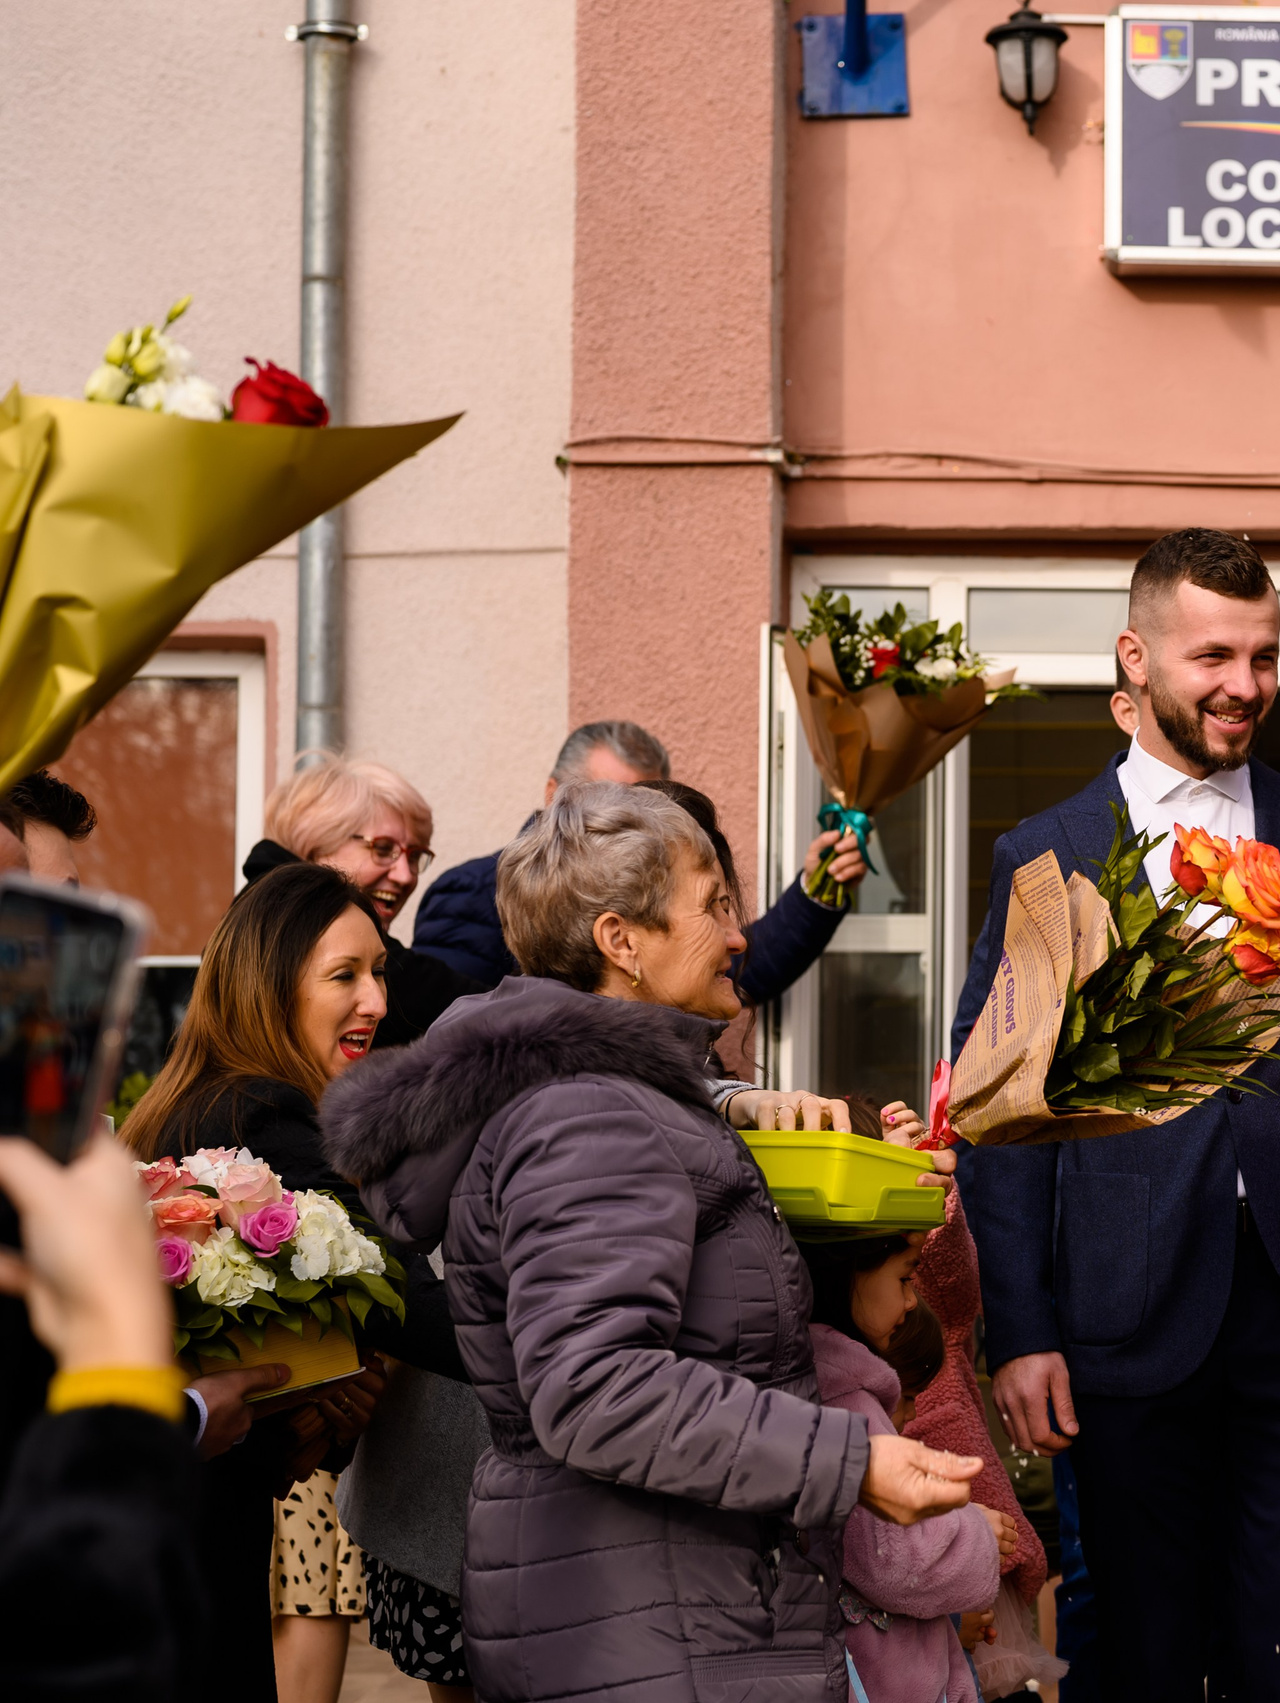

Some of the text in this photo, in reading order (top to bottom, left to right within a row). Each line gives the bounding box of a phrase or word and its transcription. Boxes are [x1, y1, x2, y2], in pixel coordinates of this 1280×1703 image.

[1215, 26, 1280, 42] ROMÂNIA
[991, 1001, 999, 1050] LEADERS
[1005, 977, 1017, 1035] GROWS
